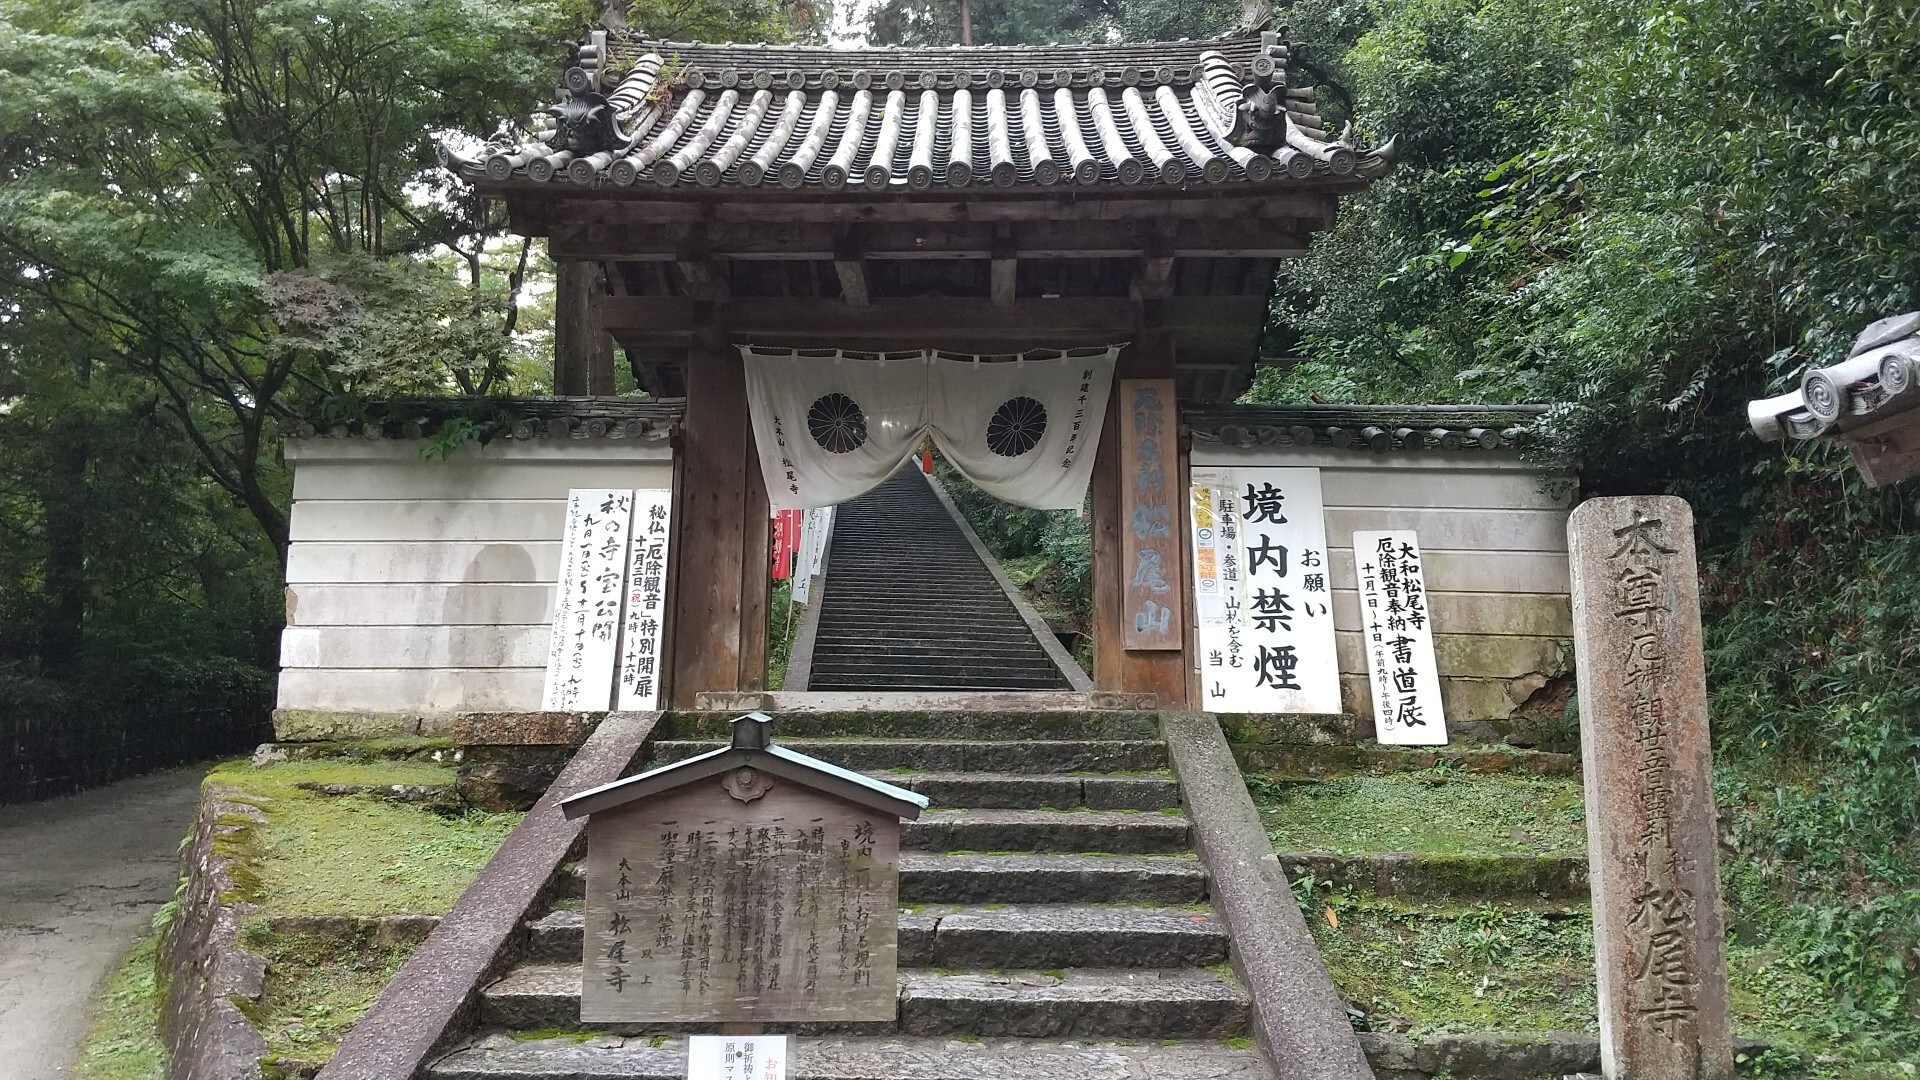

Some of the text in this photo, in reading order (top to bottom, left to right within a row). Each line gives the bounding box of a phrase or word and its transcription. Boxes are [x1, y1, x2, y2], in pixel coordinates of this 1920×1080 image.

[774, 415, 799, 495] 大本山 松尾寺
[1061, 369, 1093, 469] 創建千三百年記念
[1241, 482, 1302, 690] 境内禁煙
[1301, 548, 1327, 618] お願い
[1398, 542, 1427, 630] 大和松尾寺
[1209, 649, 1226, 698] 当山
[1386, 633, 1427, 727] 書道展
[606, 857, 632, 994] 大本山 松尾寺
[1625, 881, 1701, 1045] 松尾寺
